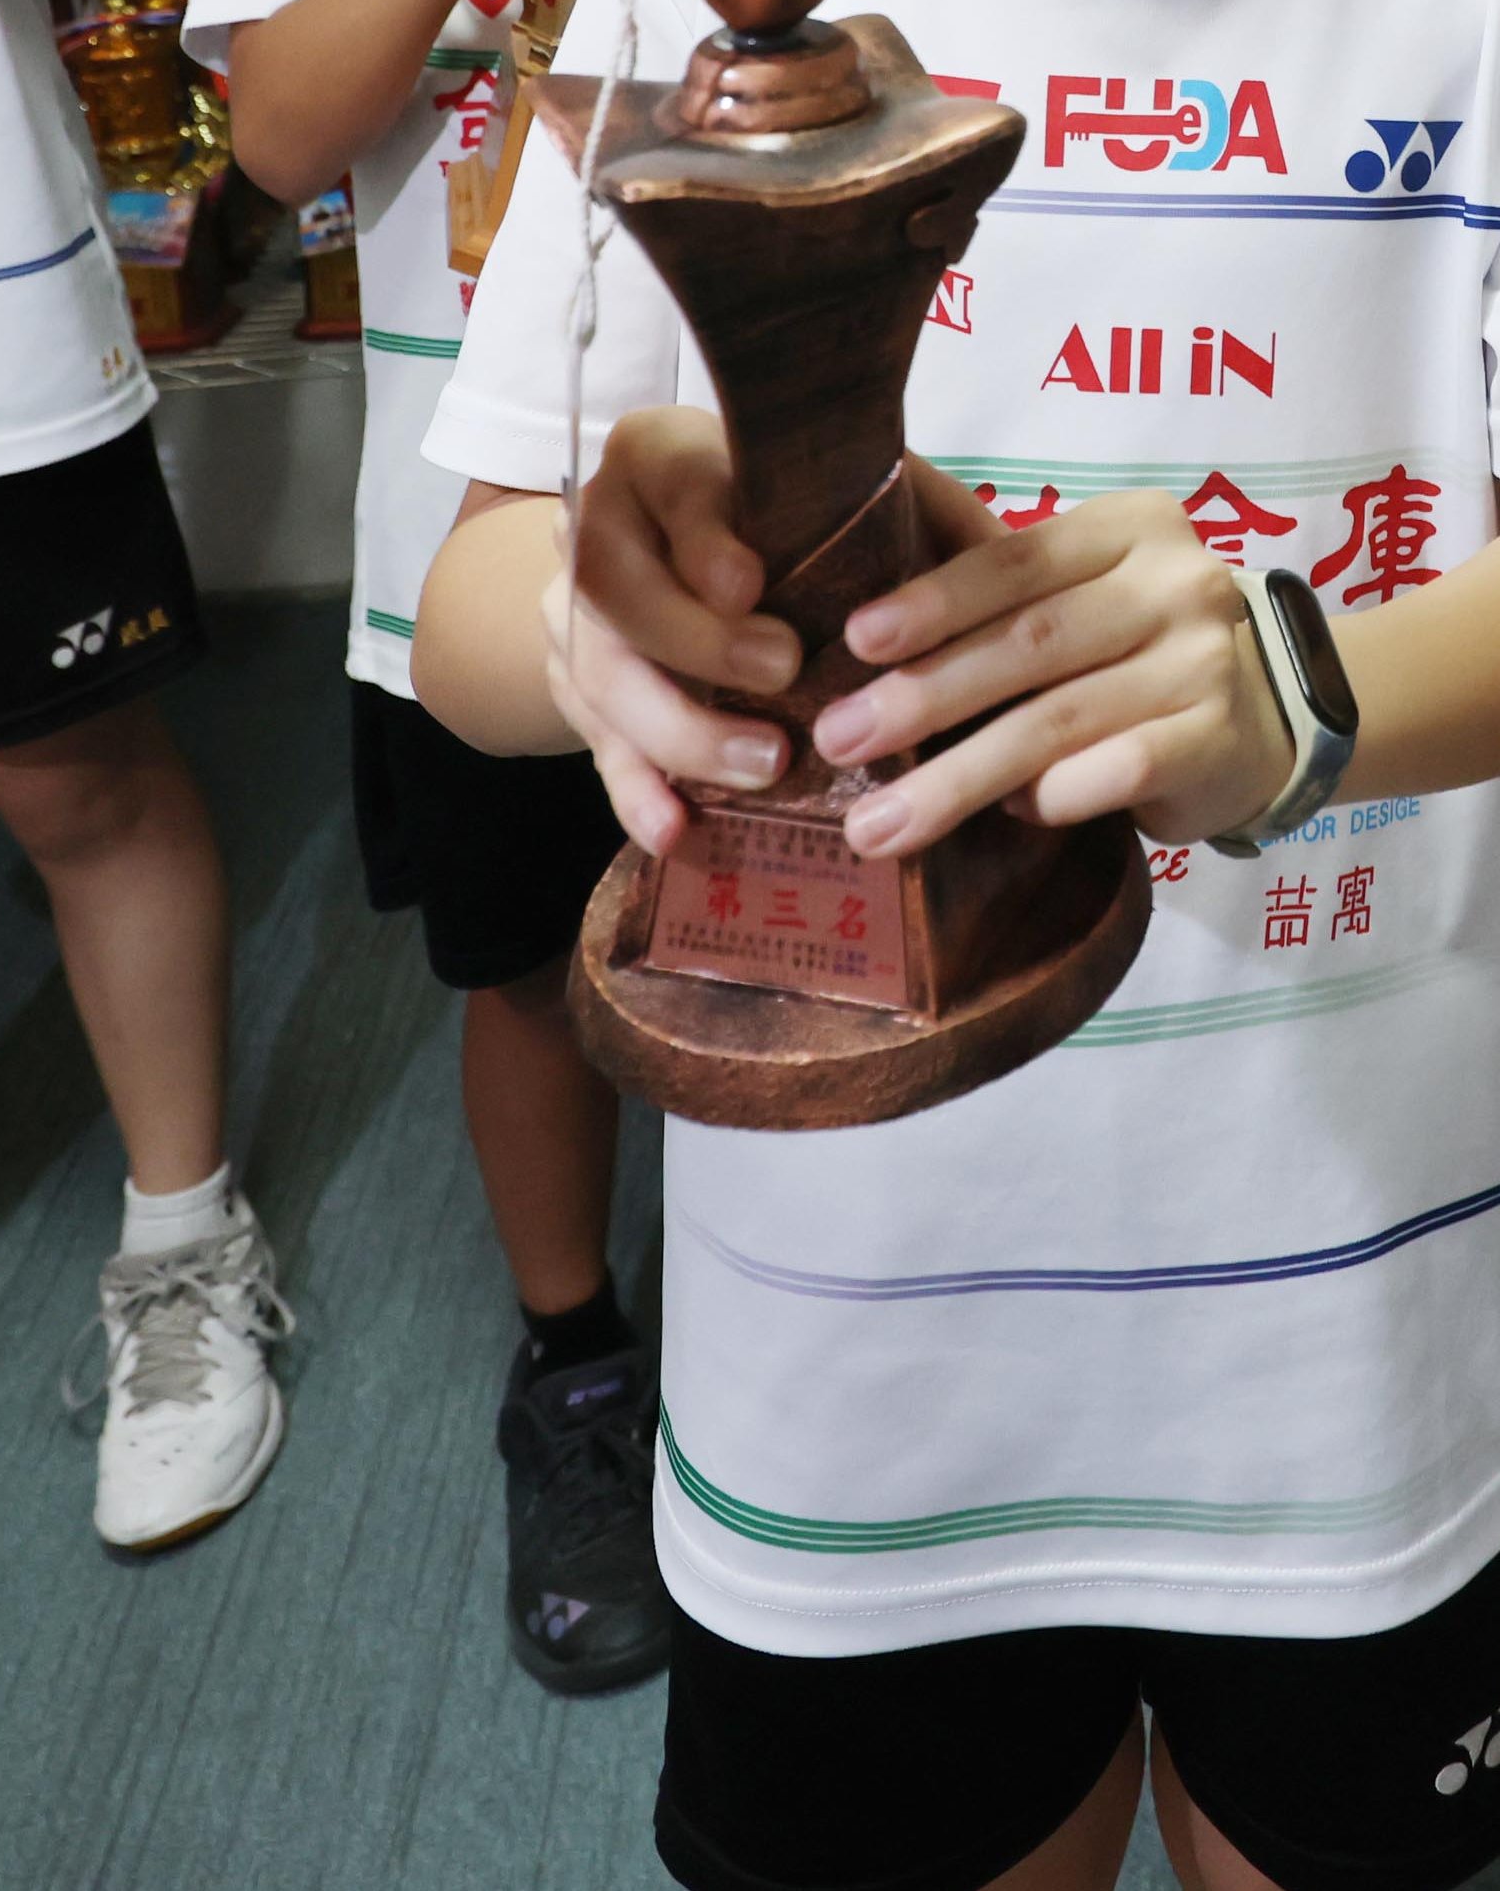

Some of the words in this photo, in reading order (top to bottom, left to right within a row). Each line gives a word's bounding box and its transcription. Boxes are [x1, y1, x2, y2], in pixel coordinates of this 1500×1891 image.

[1040, 322, 1163, 394] All
[706, 871, 868, 942] 第三名
